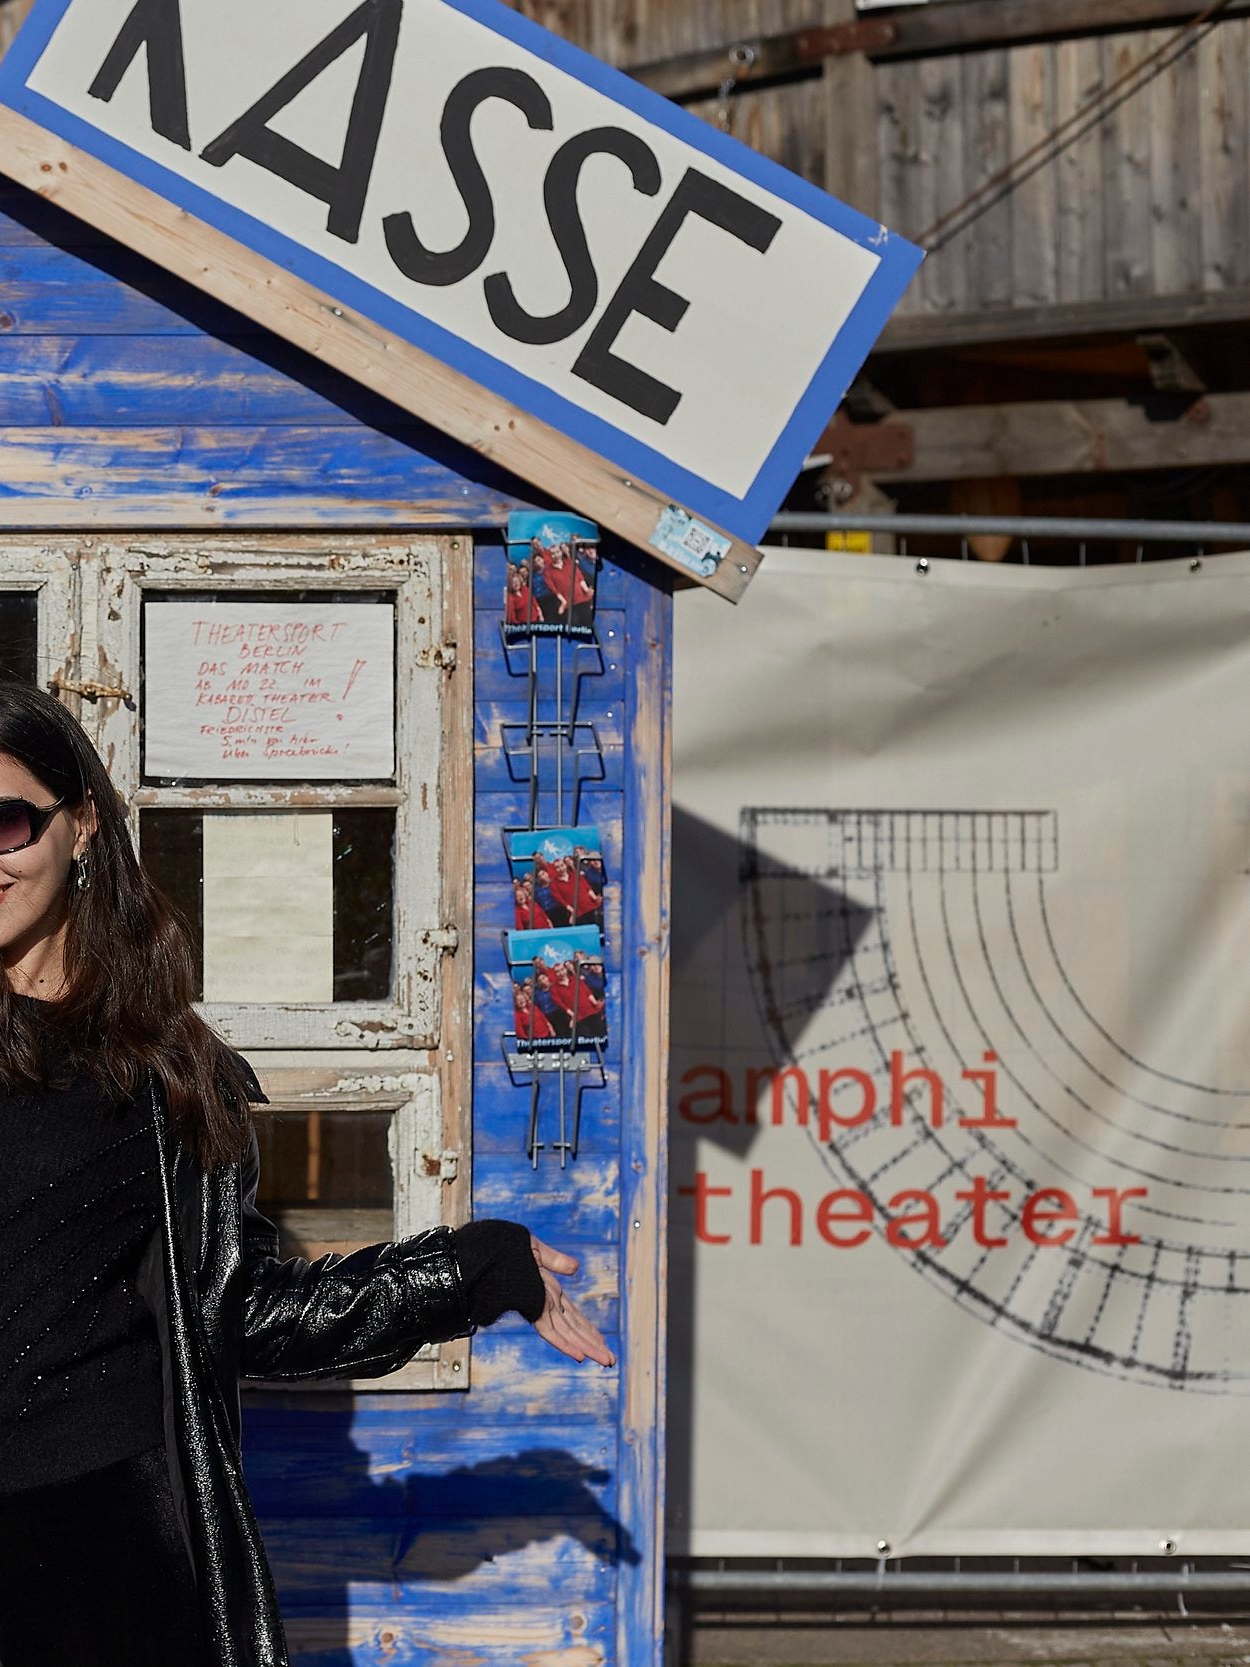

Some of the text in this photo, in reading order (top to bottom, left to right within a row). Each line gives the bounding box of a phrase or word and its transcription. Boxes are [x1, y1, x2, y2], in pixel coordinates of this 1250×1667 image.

[192, 621, 349, 645] THEATERSPORT
[239, 643, 309, 660] BERLIN
[198, 662, 228, 676] DAS
[240, 660, 305, 675] MATCH
[222, 705, 297, 724] DISTEL
[677, 1049, 1018, 1142] amphi
[677, 1169, 1148, 1248] theater
